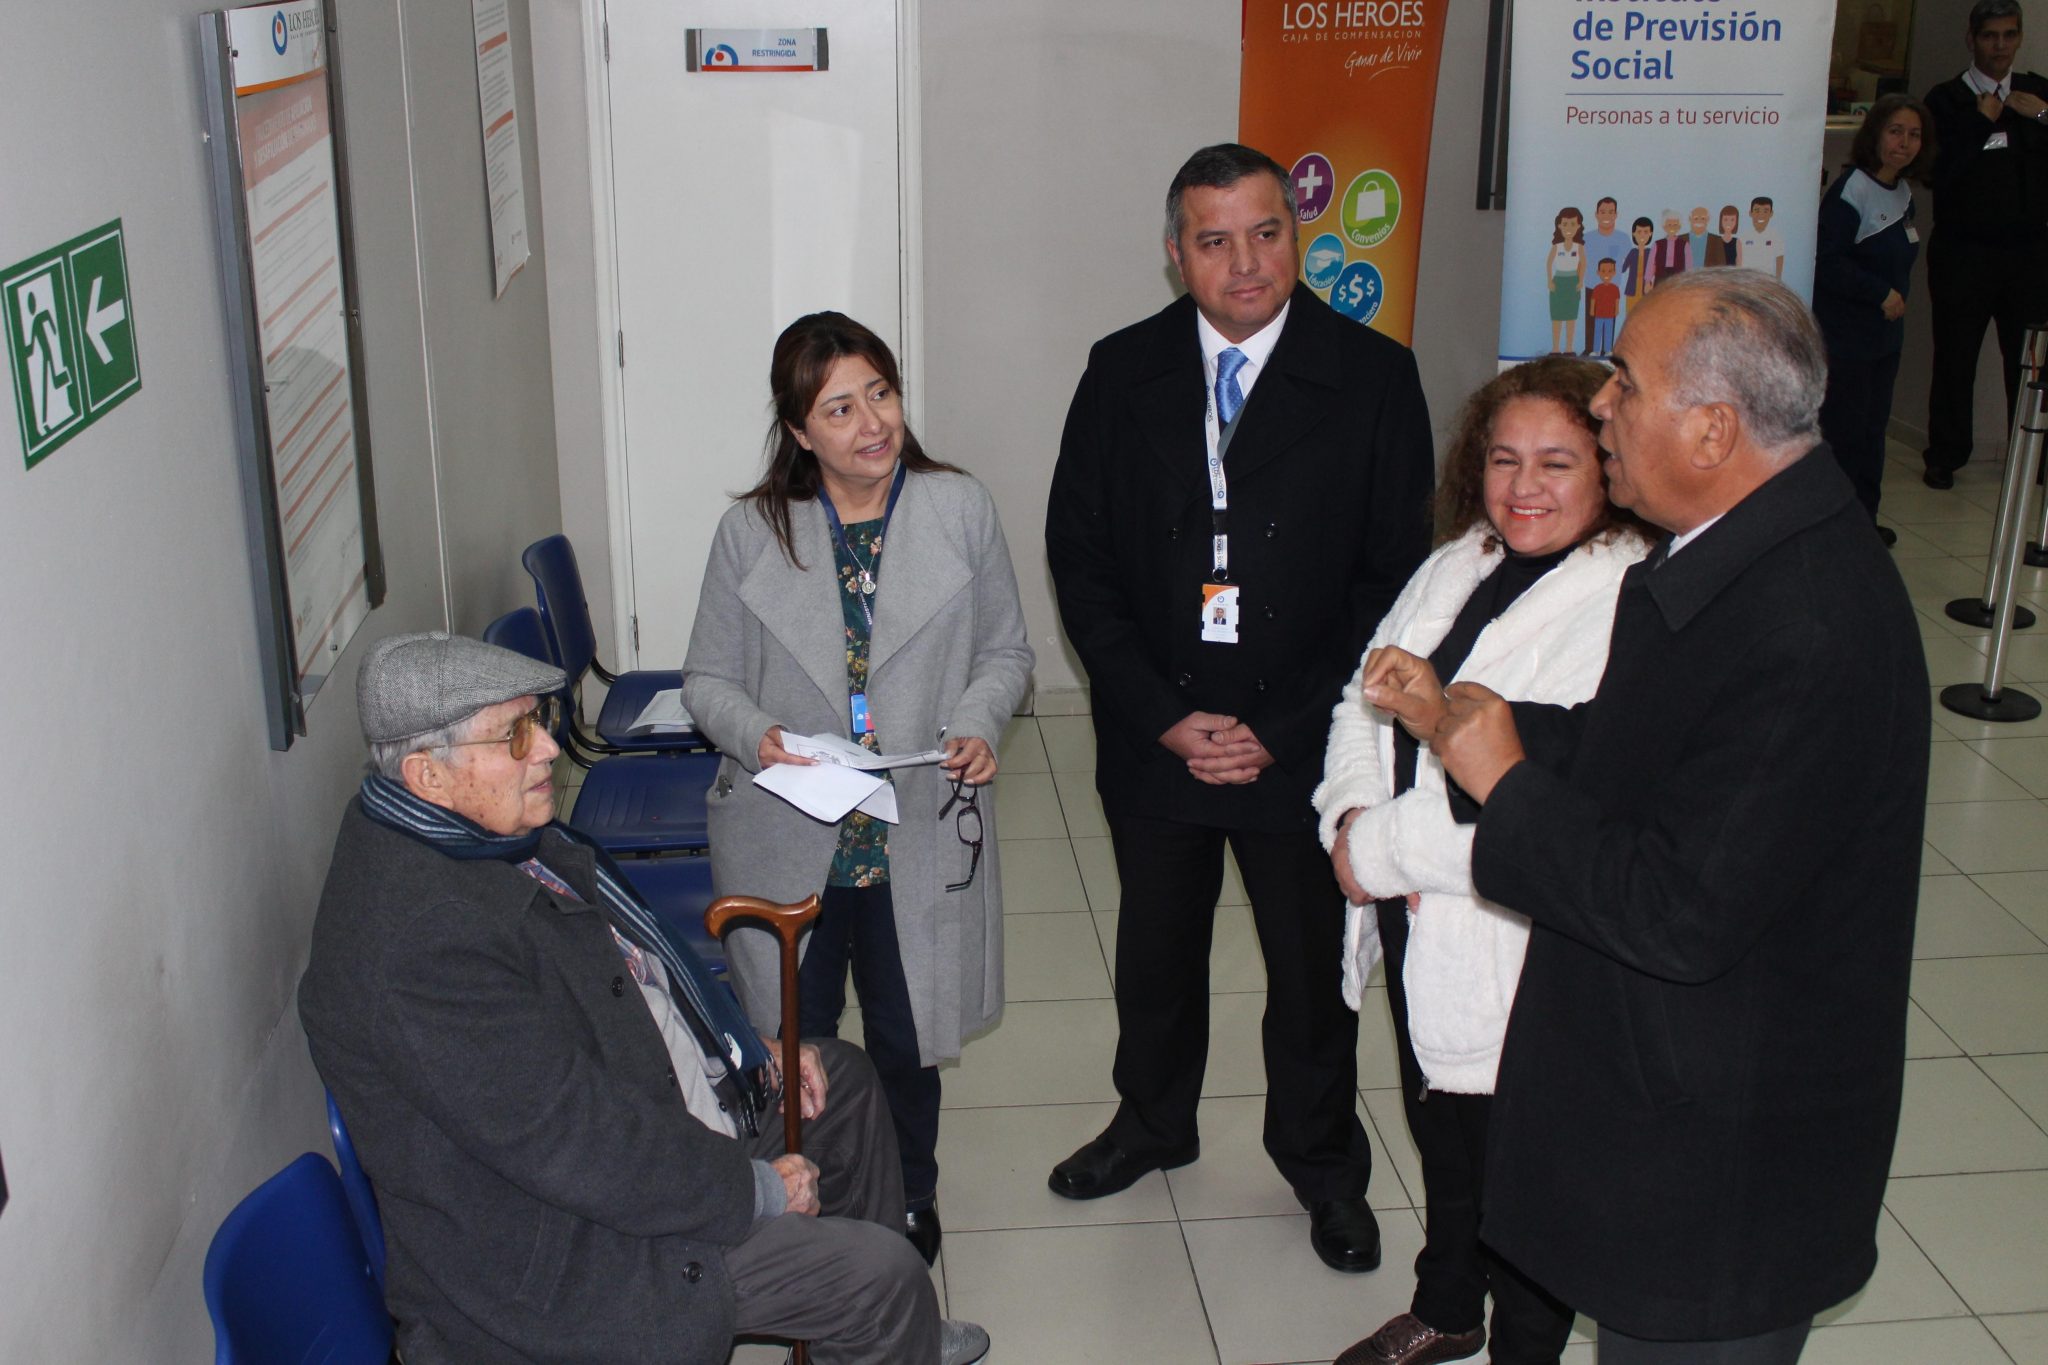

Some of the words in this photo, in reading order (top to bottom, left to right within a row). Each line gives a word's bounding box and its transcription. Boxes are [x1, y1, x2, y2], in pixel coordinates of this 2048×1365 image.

[1283, 3, 1328, 29] LOS
[1335, 1, 1423, 28] HEROES
[1573, 11, 1614, 41] de
[1624, 11, 1782, 41] Previsión
[778, 38, 796, 46] ZONA
[1282, 32, 1309, 43] CAJA
[1315, 32, 1328, 41] DE
[752, 49, 796, 57] RESTRINGIDA
[1344, 50, 1378, 77] Ganas
[1380, 46, 1394, 63] de
[1397, 41, 1422, 62] Vivir
[1571, 50, 1674, 80] Social
[1566, 106, 1653, 125] Personas
[1659, 110, 1670, 125] a
[1677, 108, 1697, 125] tu
[1703, 106, 1780, 125] servicio
[1300, 206, 1318, 220] Salud
[1351, 223, 1391, 244] Convenios
